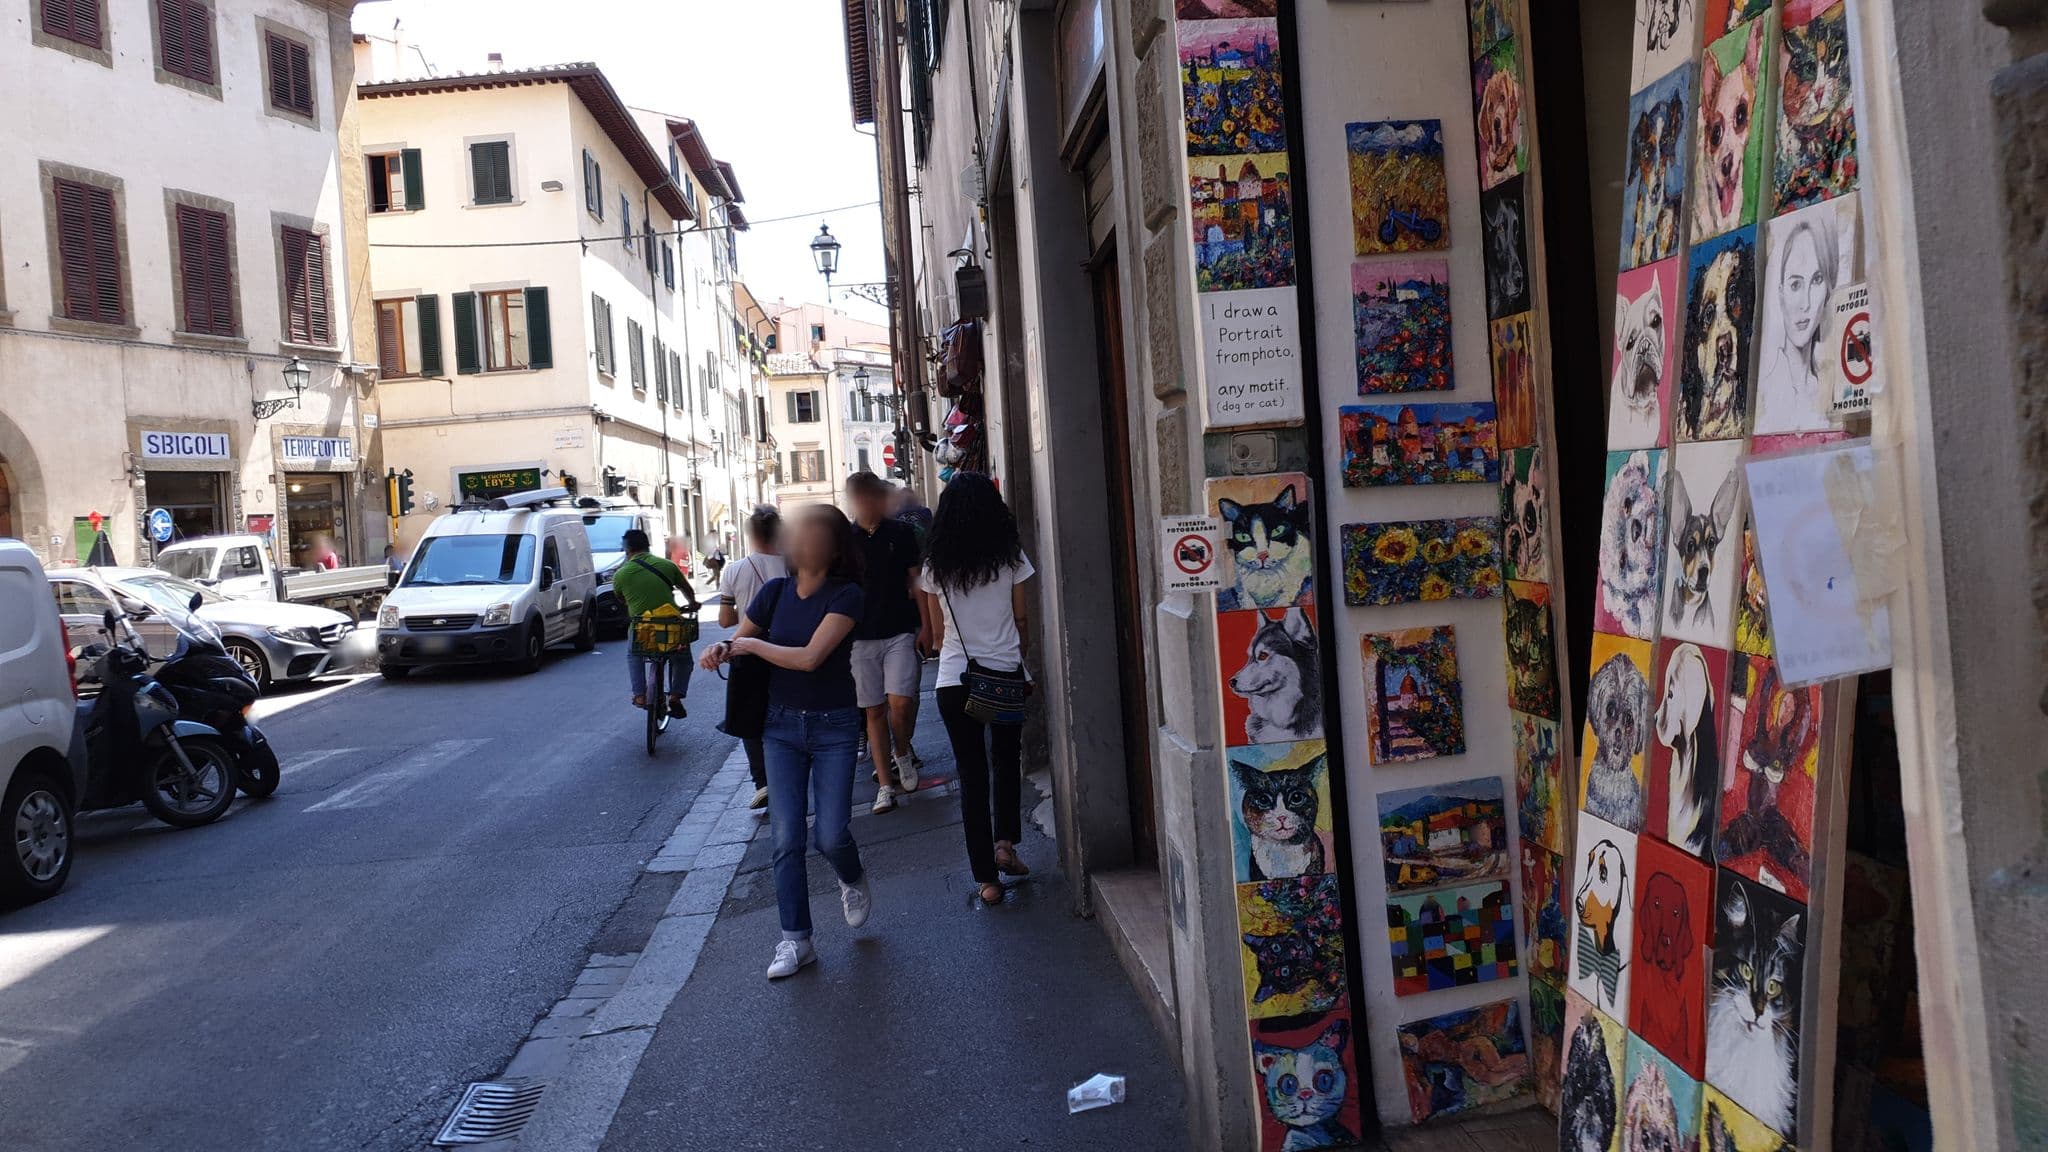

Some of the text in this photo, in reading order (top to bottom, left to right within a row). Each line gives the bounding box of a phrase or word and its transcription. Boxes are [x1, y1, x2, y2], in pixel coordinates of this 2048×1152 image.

[1224, 302, 1263, 318] draw
[1267, 306, 1278, 316] a
[1219, 324, 1283, 342] Portrait
[1218, 379, 1289, 398] any motif.
[1853, 388, 1864, 398] NO
[1216, 401, 1241, 413] (dog
[1259, 397, 1285, 408] cat)
[147, 434, 226, 455] SBIGOLI
[283, 438, 350, 457] TERRECOTTE
[485, 478, 516, 487] EBY'S
